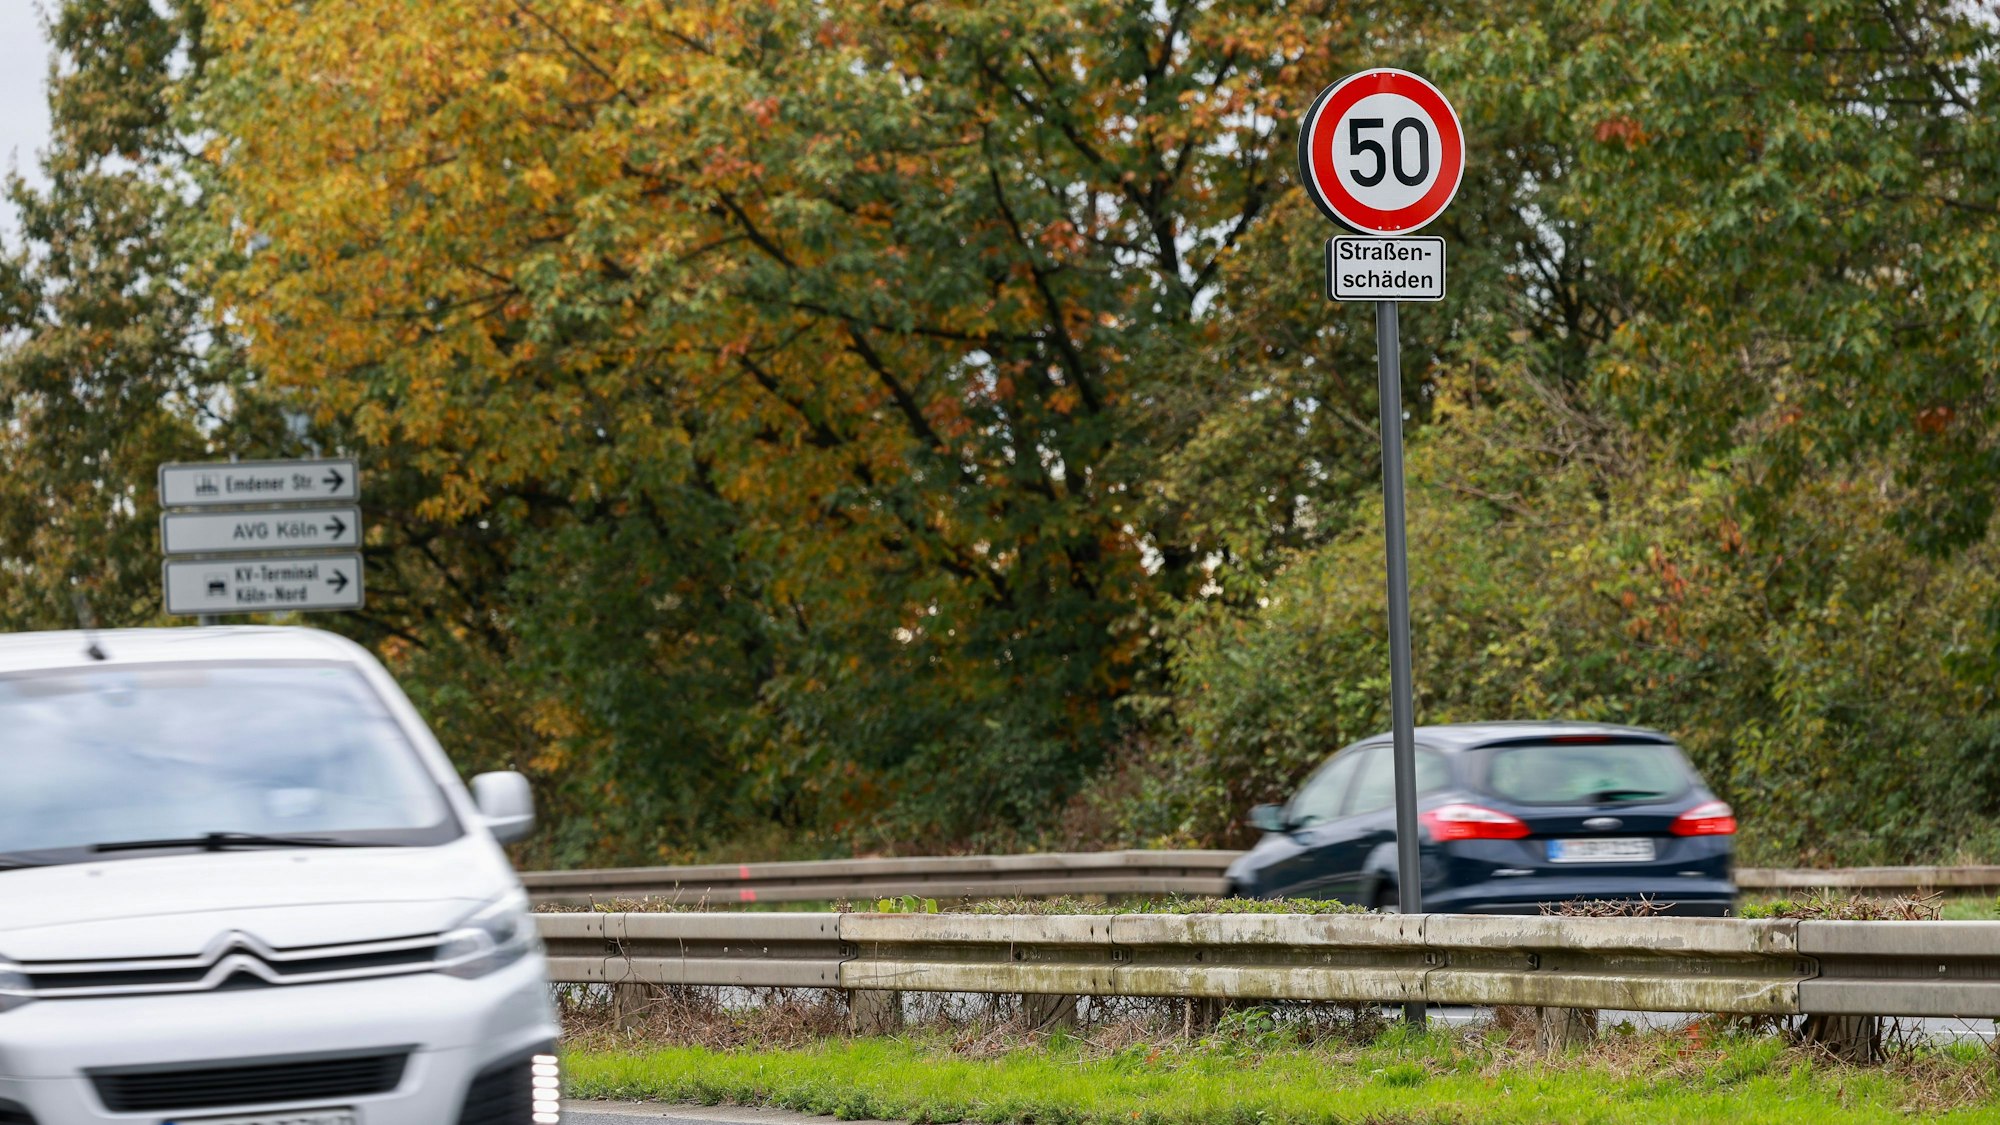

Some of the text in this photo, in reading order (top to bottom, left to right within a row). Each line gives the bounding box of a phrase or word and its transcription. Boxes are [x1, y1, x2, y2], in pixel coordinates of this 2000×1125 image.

[1349, 117, 1429, 187] 50
[1340, 242, 1432, 261] Straßen-
[1343, 270, 1433, 288] schäden
[226, 473, 316, 493] Emdener Str.
[233, 521, 318, 540] AVG Köln
[235, 564, 319, 583] KV-Terminal
[236, 586, 308, 604] Köln-Nord
